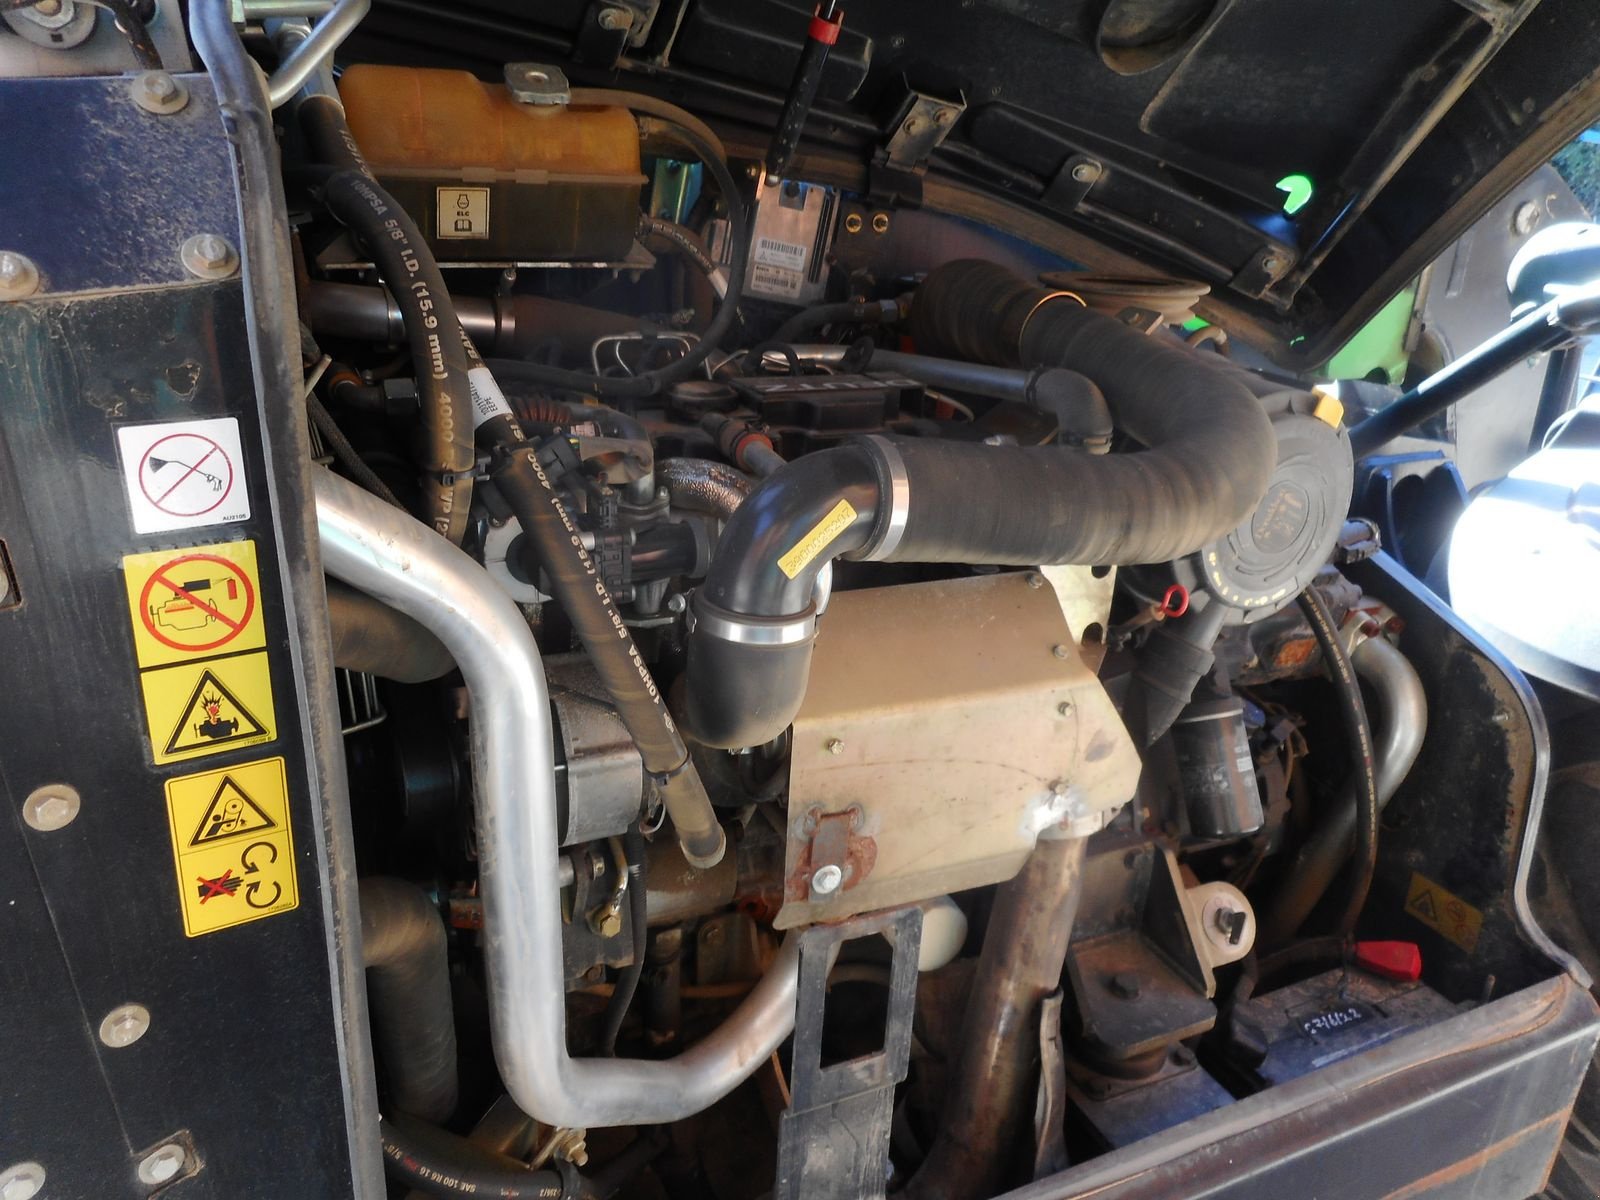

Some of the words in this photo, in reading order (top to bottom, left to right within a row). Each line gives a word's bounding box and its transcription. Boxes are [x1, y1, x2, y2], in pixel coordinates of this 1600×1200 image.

[400, 249, 420, 278] I.D.
[411, 281, 438, 329] (15.9
[428, 334, 449, 379] mm)
[439, 391, 454, 442] 4000
[527, 453, 551, 490] 4000
[571, 534, 597, 575] (15.9
[607, 609, 628, 639] 5/8"
[628, 643, 660, 705] 10HPSA
[443, 1177, 459, 1190] 100
